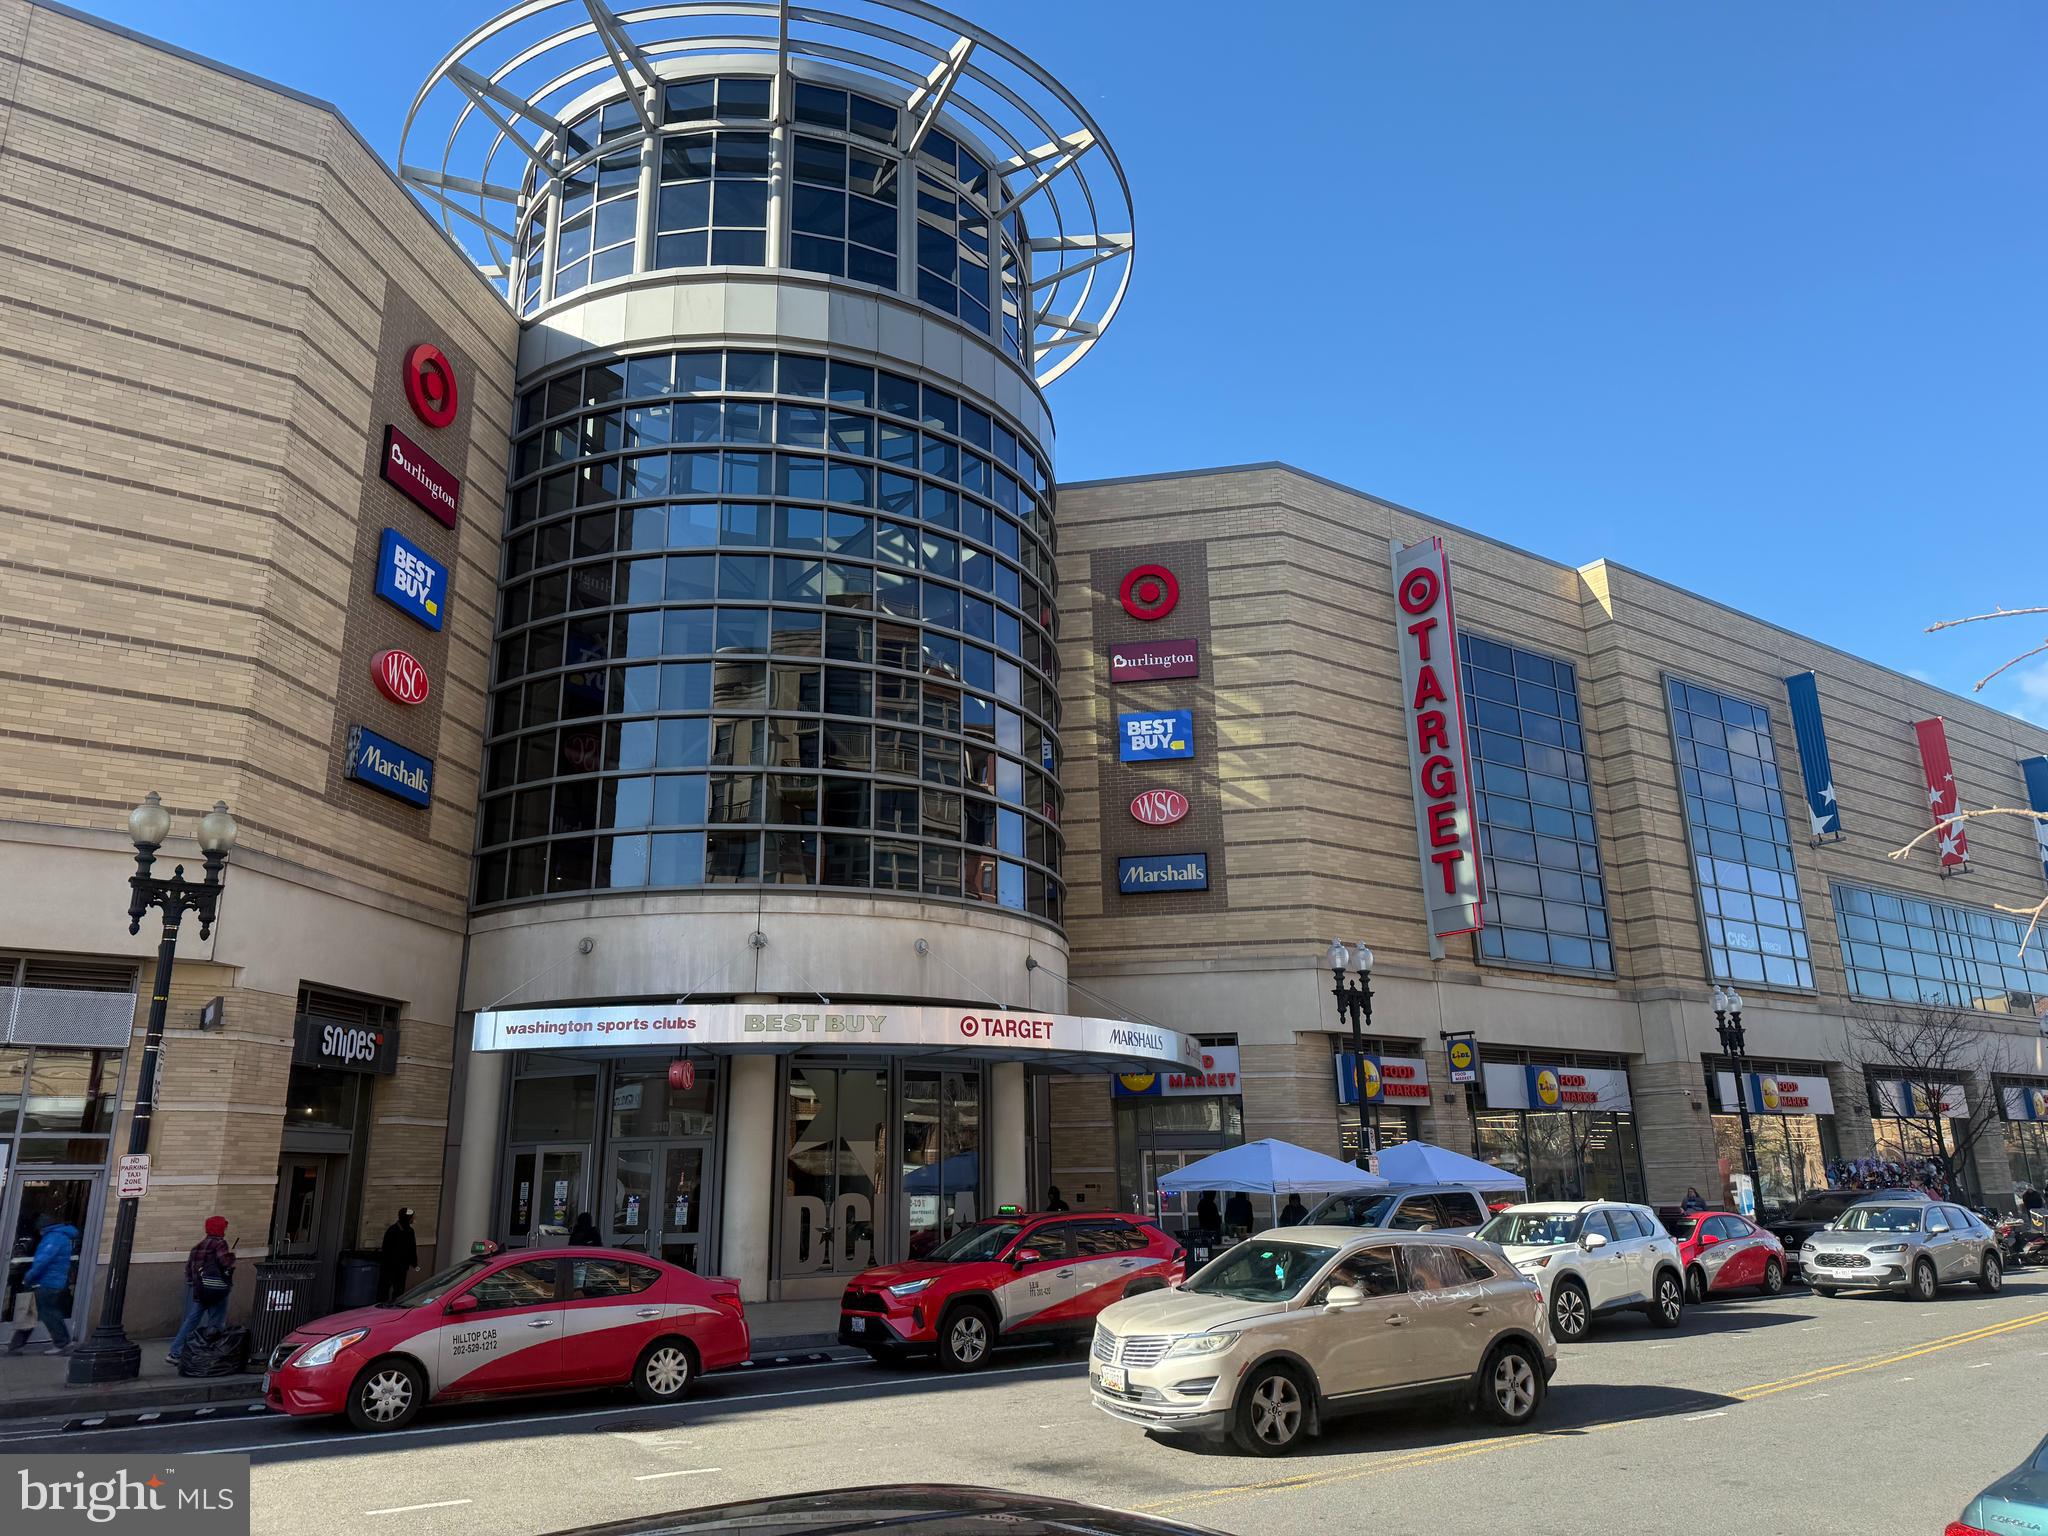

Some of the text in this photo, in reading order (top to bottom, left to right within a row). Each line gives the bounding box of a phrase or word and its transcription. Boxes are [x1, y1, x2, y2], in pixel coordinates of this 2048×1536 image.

[391, 443, 455, 509] Burlington
[393, 544, 435, 588] BEST
[394, 567, 430, 605] BUY
[1113, 653, 1194, 668] Burlington
[388, 653, 423, 699] WSC
[1127, 719, 1176, 736] BEST
[1131, 734, 1173, 750] BUY
[1408, 617, 1464, 894] TARGET
[360, 745, 429, 793] Marshalls
[1137, 792, 1180, 821] WSC
[1123, 863, 1204, 884] Marshalls
[505, 1017, 697, 1035] washington sports clubs
[744, 1013, 887, 1032] BEST BUY
[981, 1018, 1053, 1040] TARGET
[322, 1025, 376, 1064] snipes
[1109, 1028, 1163, 1051] MARSHALLS
[1169, 1072, 1236, 1089] MARKET
[1382, 1065, 1415, 1078] FOOD
[1559, 1075, 1586, 1086] FOOD
[1561, 1091, 1598, 1103] MARKET
[452, 1329, 498, 1345] HILLTOP CAB
[453, 1340, 498, 1356] 202-529-1212
